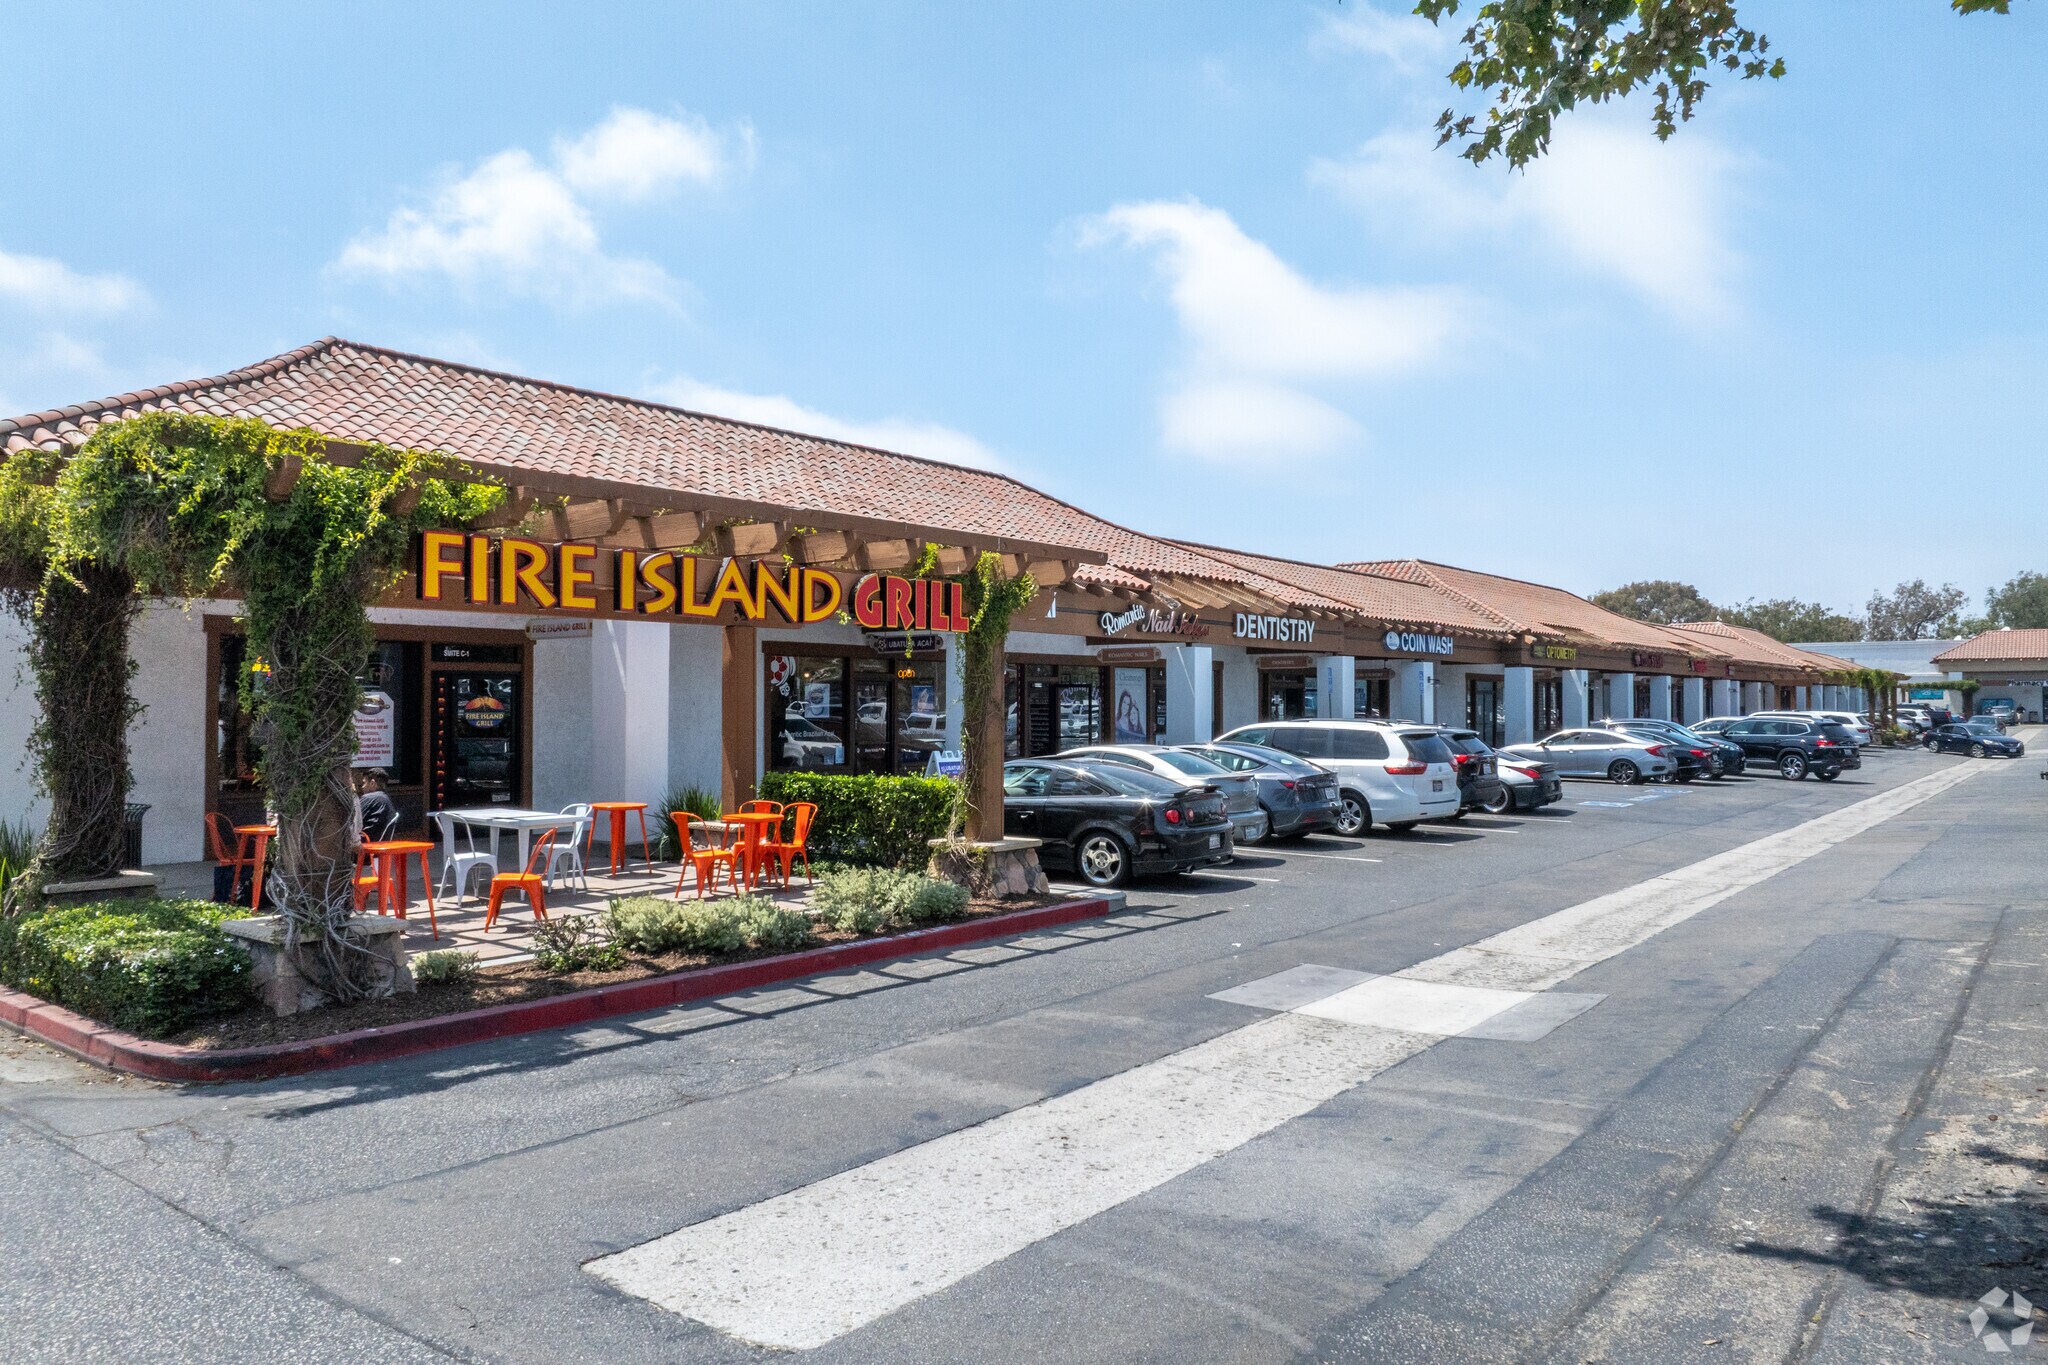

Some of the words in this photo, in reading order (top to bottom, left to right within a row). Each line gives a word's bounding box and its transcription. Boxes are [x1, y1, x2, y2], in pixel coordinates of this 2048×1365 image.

[419, 530, 598, 610] FIRE
[615, 549, 842, 624] ISLAND
[852, 572, 970, 633] GRILL
[1101, 604, 1146, 636] Romantic
[1142, 608, 1175, 633] Nail
[532, 624, 546, 633] FIRE
[547, 623, 571, 633] ISLAND
[572, 622, 587, 630] GRILL
[1236, 613, 1316, 643] DENTISTRY
[888, 639, 916, 648] UBATUA
[1401, 632, 1426, 653] COIN
[1428, 635, 1454, 655] WASH
[443, 649, 460, 657] SUITE
[1546, 645, 1577, 661] OPTOMETRY
[897, 669, 916, 679] open
[2006, 679, 2044, 688] Pharmacy
[778, 730, 803, 738] Auentic
